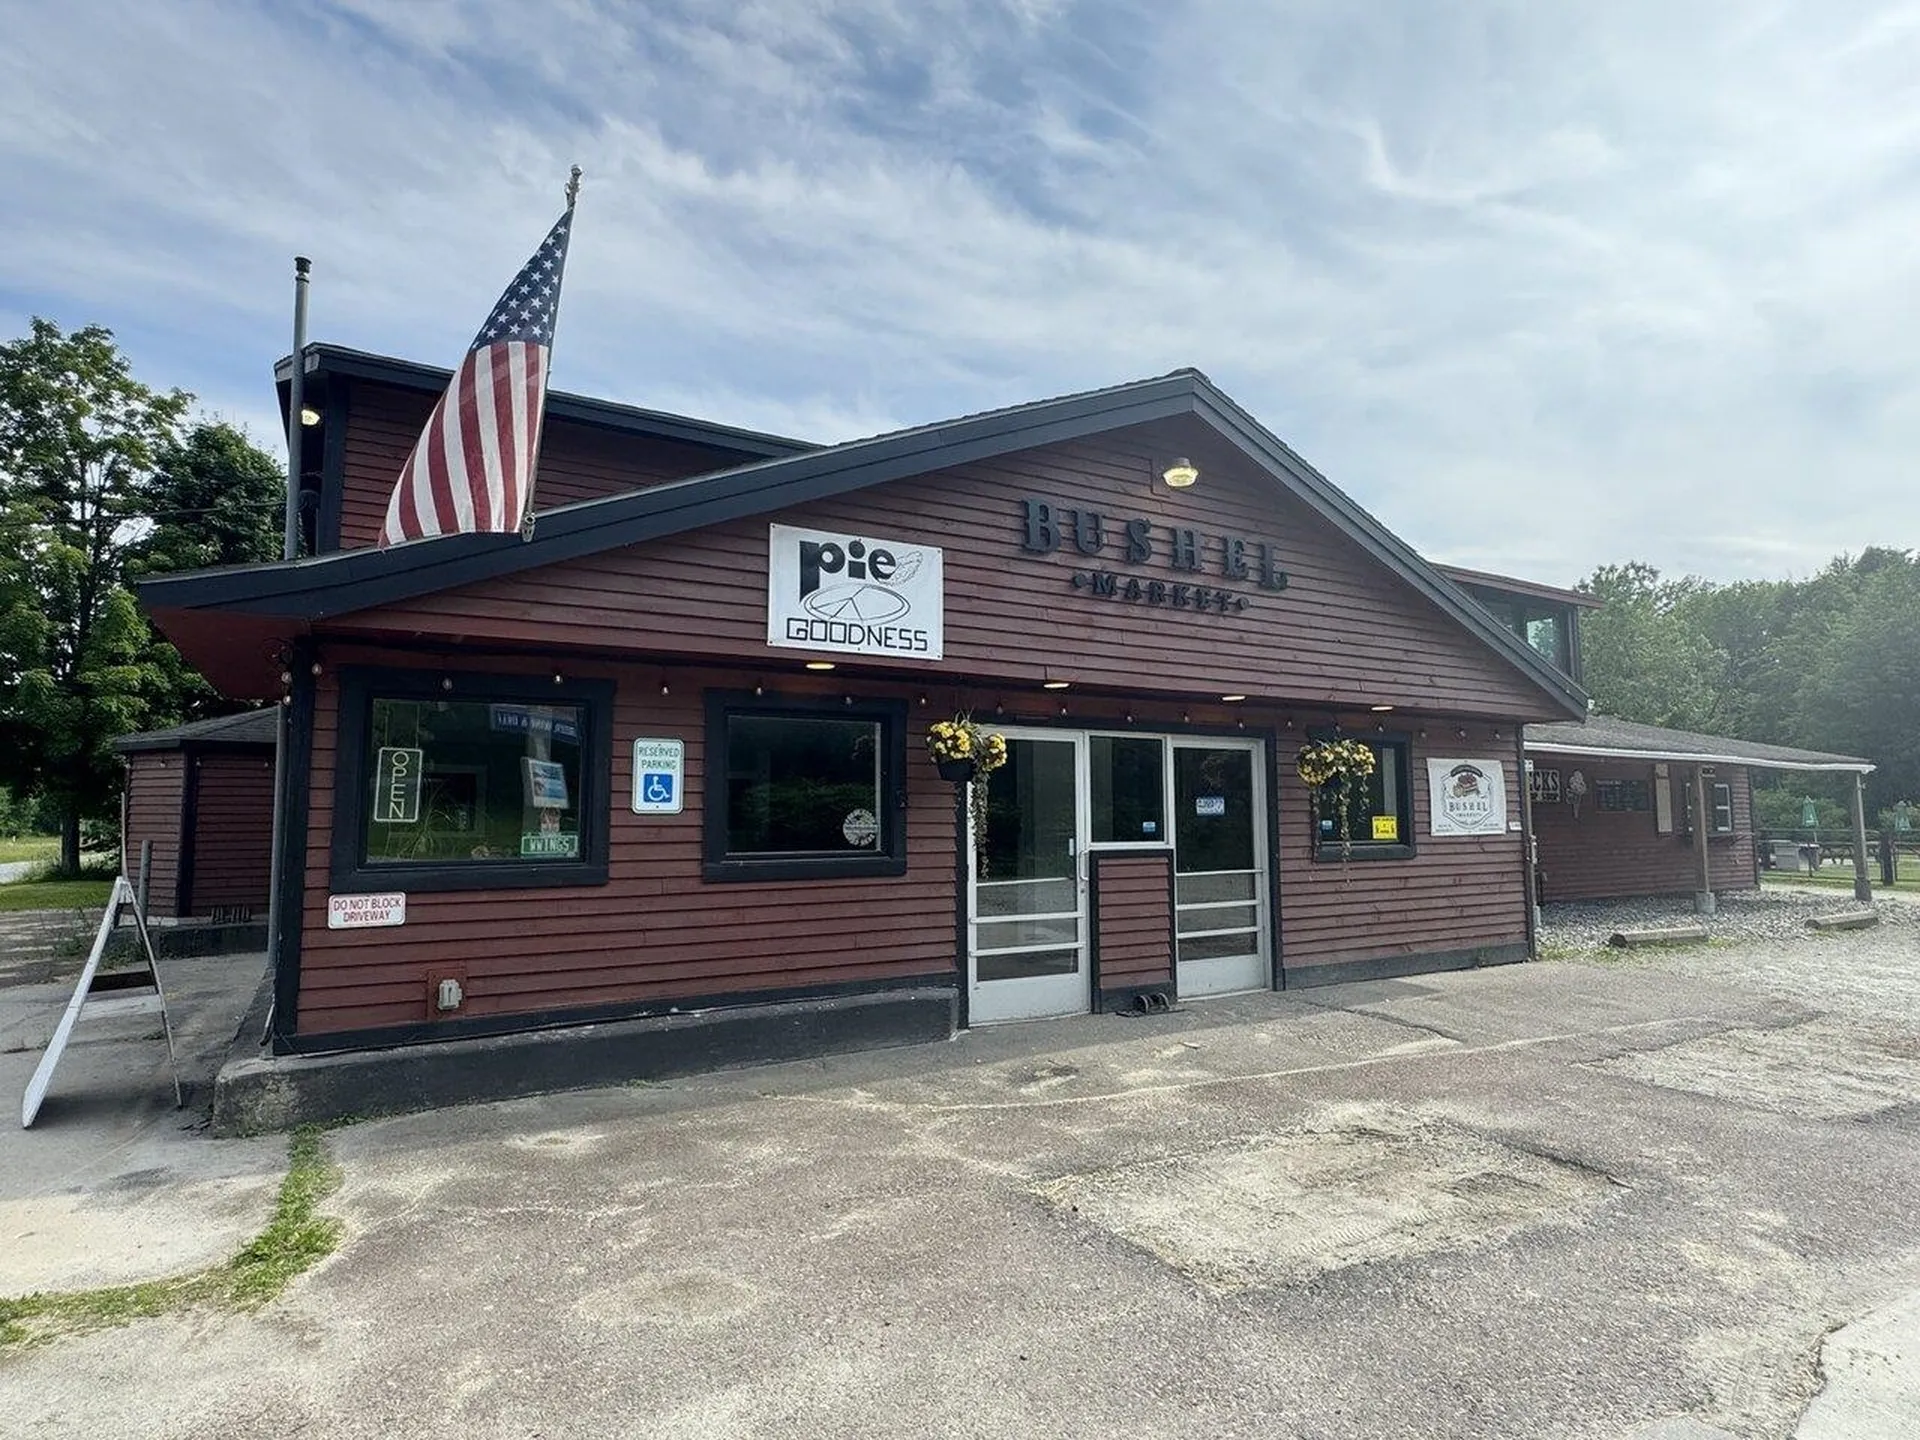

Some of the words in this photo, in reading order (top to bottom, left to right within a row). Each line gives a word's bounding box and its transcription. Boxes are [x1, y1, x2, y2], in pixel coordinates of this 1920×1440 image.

[1021, 499, 1288, 592] BUSHEL
[799, 540, 896, 603] pie
[1091, 572, 1233, 612] MARKET
[786, 617, 928, 651] GOODNESS
[638, 747, 680, 757] RESERVED
[641, 760, 676, 770] PARKING
[388, 751, 409, 818] OPEN
[333, 900, 348, 911] DO
[349, 898, 370, 910] NOT
[371, 896, 401, 909] BLOCK
[343, 910, 391, 922] DRIVEWAY
